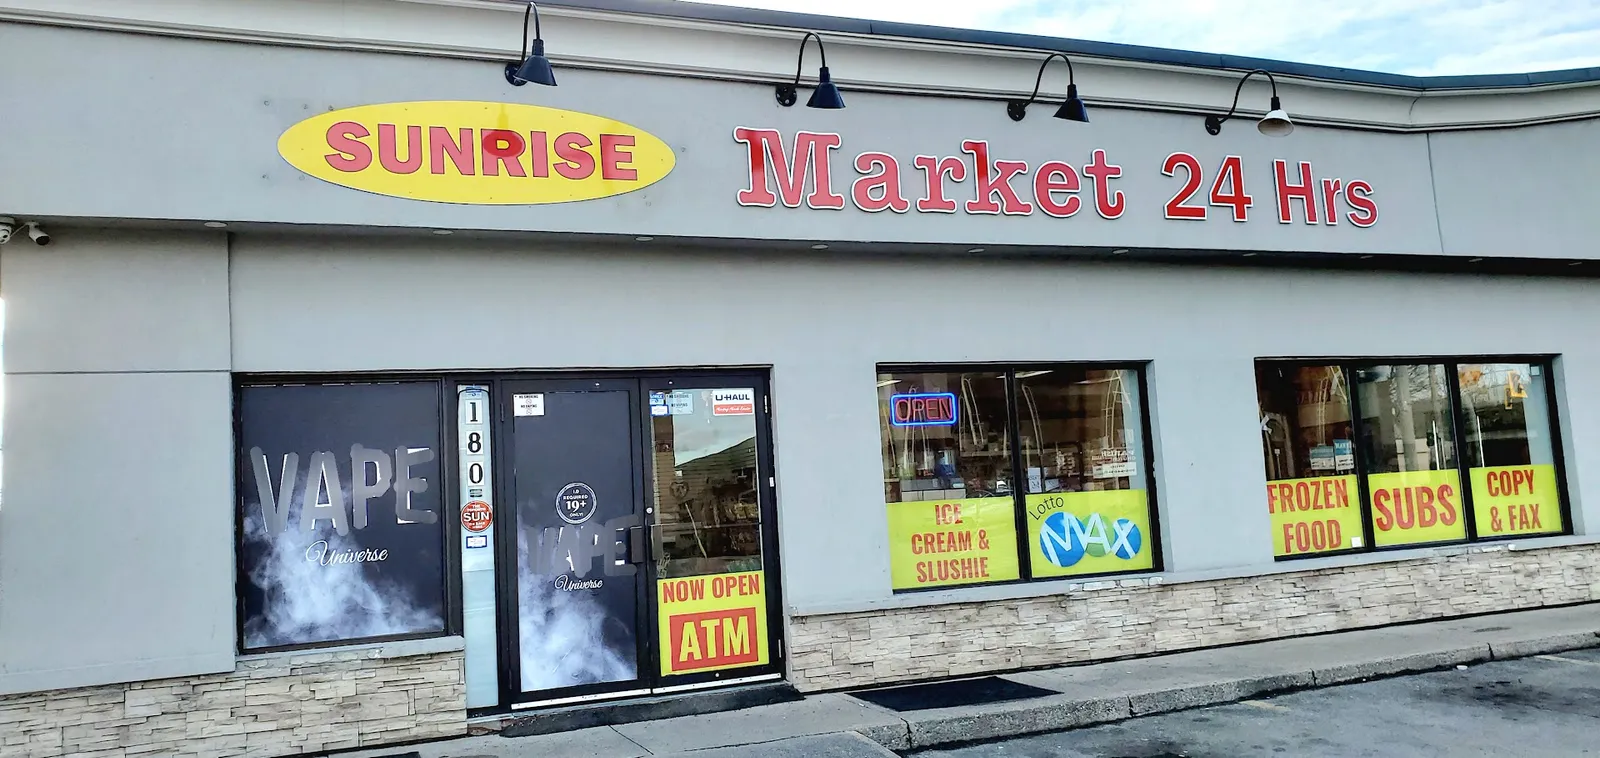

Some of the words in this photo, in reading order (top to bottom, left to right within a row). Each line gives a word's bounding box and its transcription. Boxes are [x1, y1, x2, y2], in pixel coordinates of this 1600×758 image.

[324, 121, 638, 181] SUNRISE
[733, 126, 1126, 220] Market
[1161, 151, 1253, 222] 24
[1272, 158, 1379, 228] Hrs
[895, 397, 953, 421] OPEN
[250, 443, 438, 537] VAPE
[1267, 478, 1350, 514] FROZEN
[1486, 469, 1535, 497] COPY
[463, 511, 490, 522] SUN
[565, 500, 587, 513] 19+
[935, 503, 963, 526] ICE
[1028, 495, 1065, 521] Lotto
[1373, 484, 1457, 531] SUBS
[1490, 506, 1503, 532] &
[1508, 503, 1542, 531] FAX
[911, 530, 972, 555] CREAM
[978, 529, 990, 550] &
[1040, 512, 1138, 567] MAX
[1283, 519, 1342, 554] FOOD
[305, 540, 389, 567] Universe
[554, 574, 603, 592] Universe
[916, 557, 990, 583] SLUSHIE
[662, 579, 705, 603] NOW
[711, 574, 760, 598] OPEN
[679, 615, 751, 662] ATM
